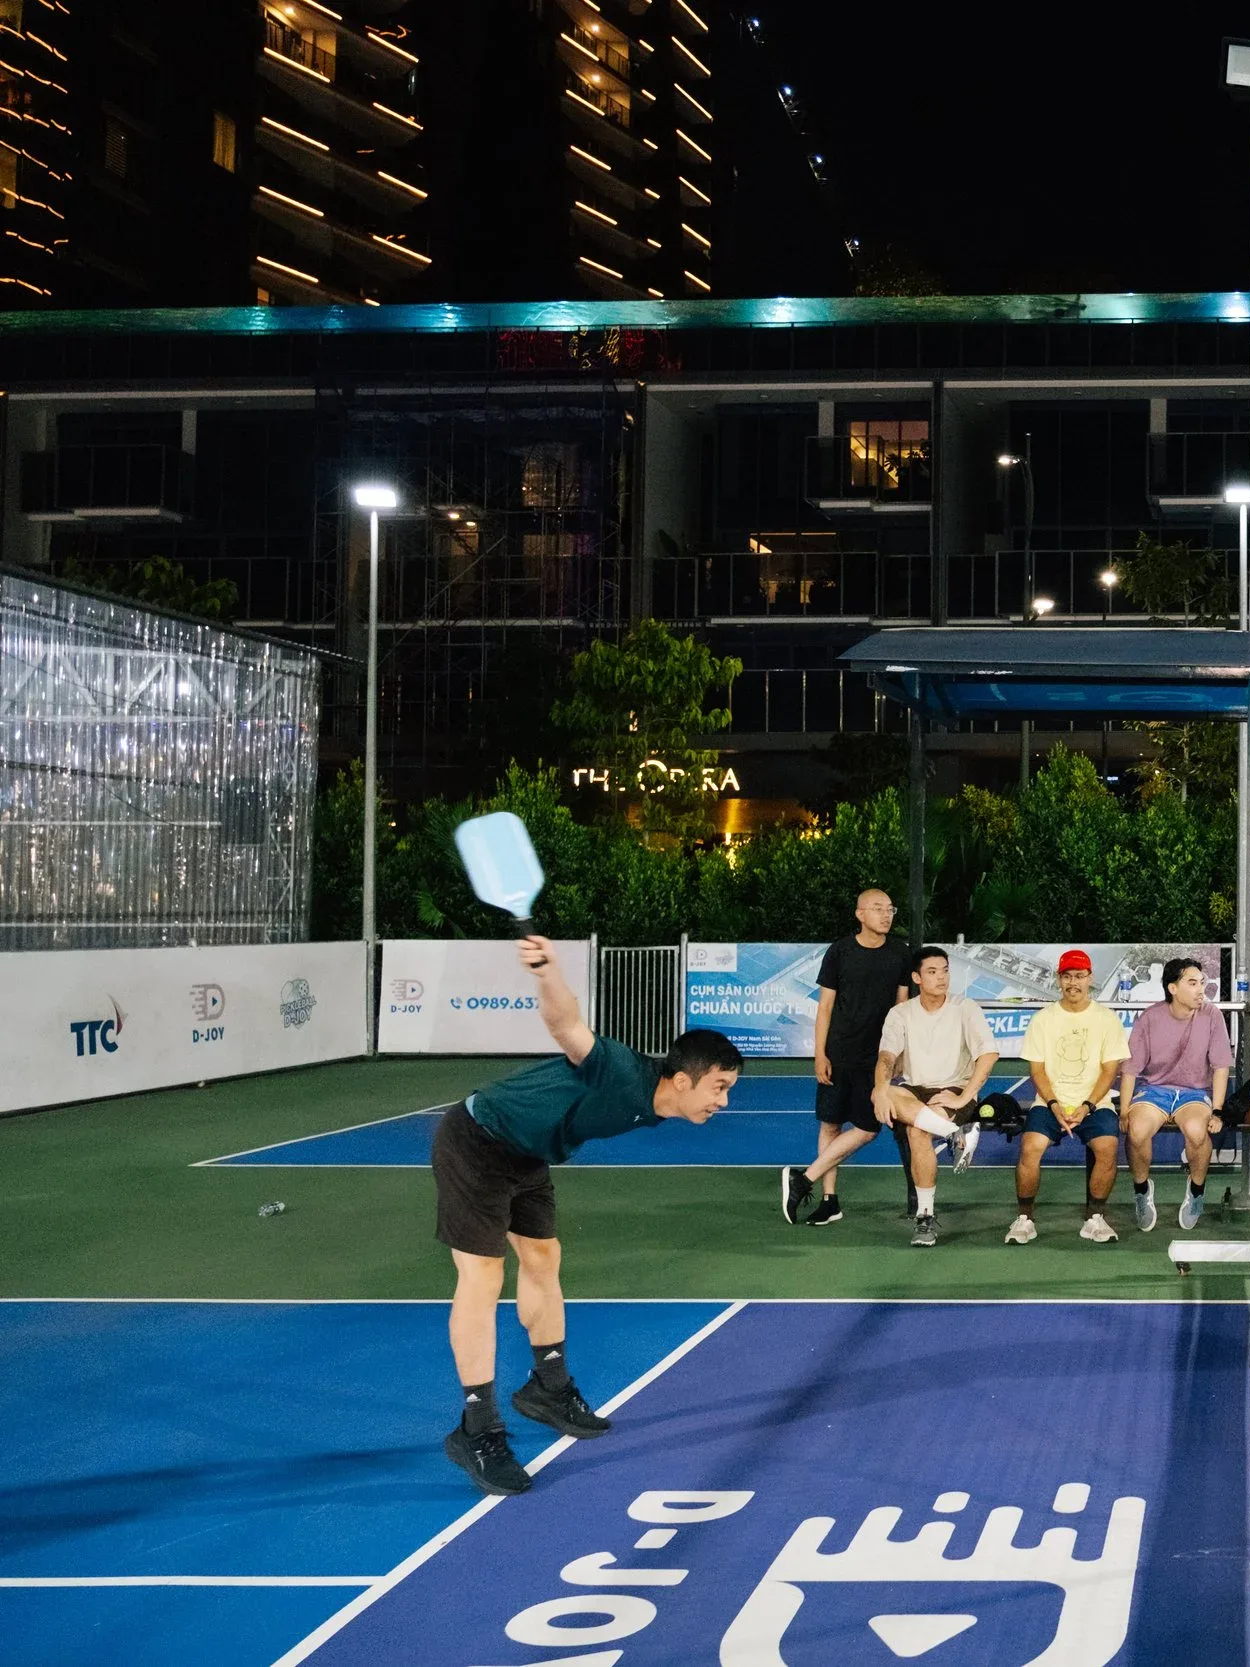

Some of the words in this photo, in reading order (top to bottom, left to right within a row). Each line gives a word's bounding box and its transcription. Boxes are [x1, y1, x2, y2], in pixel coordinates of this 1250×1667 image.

[572, 767, 626, 792] TH
[690, 984, 717, 999] CỤM
[717, 982, 742, 996] SÂN
[390, 1004, 423, 1014] D-JOY
[466, 997, 541, 1010] 0989.63
[690, 996, 741, 1015] CHUẨN
[70, 1019, 119, 1057] TTC
[192, 1026, 225, 1043] D-JOY
[467, 1490, 755, 1667] D-JO
